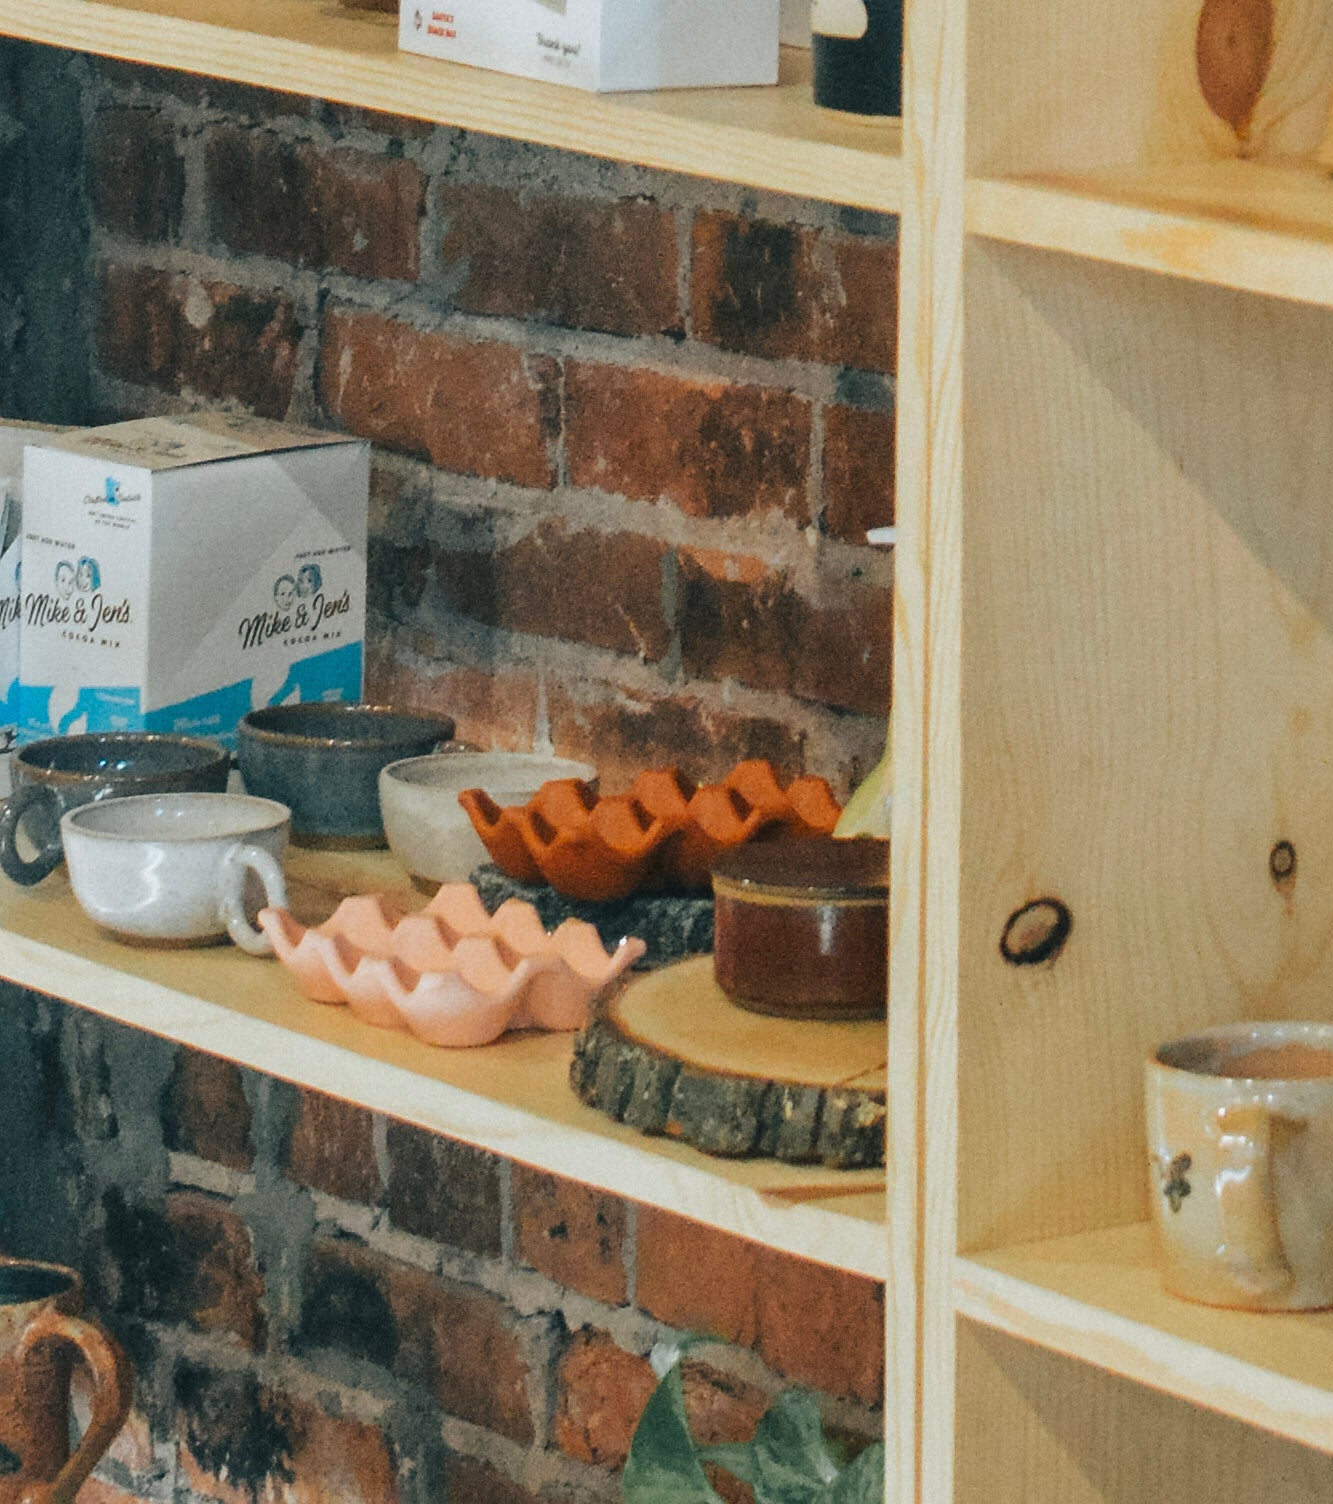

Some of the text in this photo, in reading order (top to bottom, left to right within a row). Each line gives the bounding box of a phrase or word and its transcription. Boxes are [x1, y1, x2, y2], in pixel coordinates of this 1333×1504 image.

[25, 592, 131, 632] Mike & Jen's
[238, 589, 350, 650] Mike & Jen's
